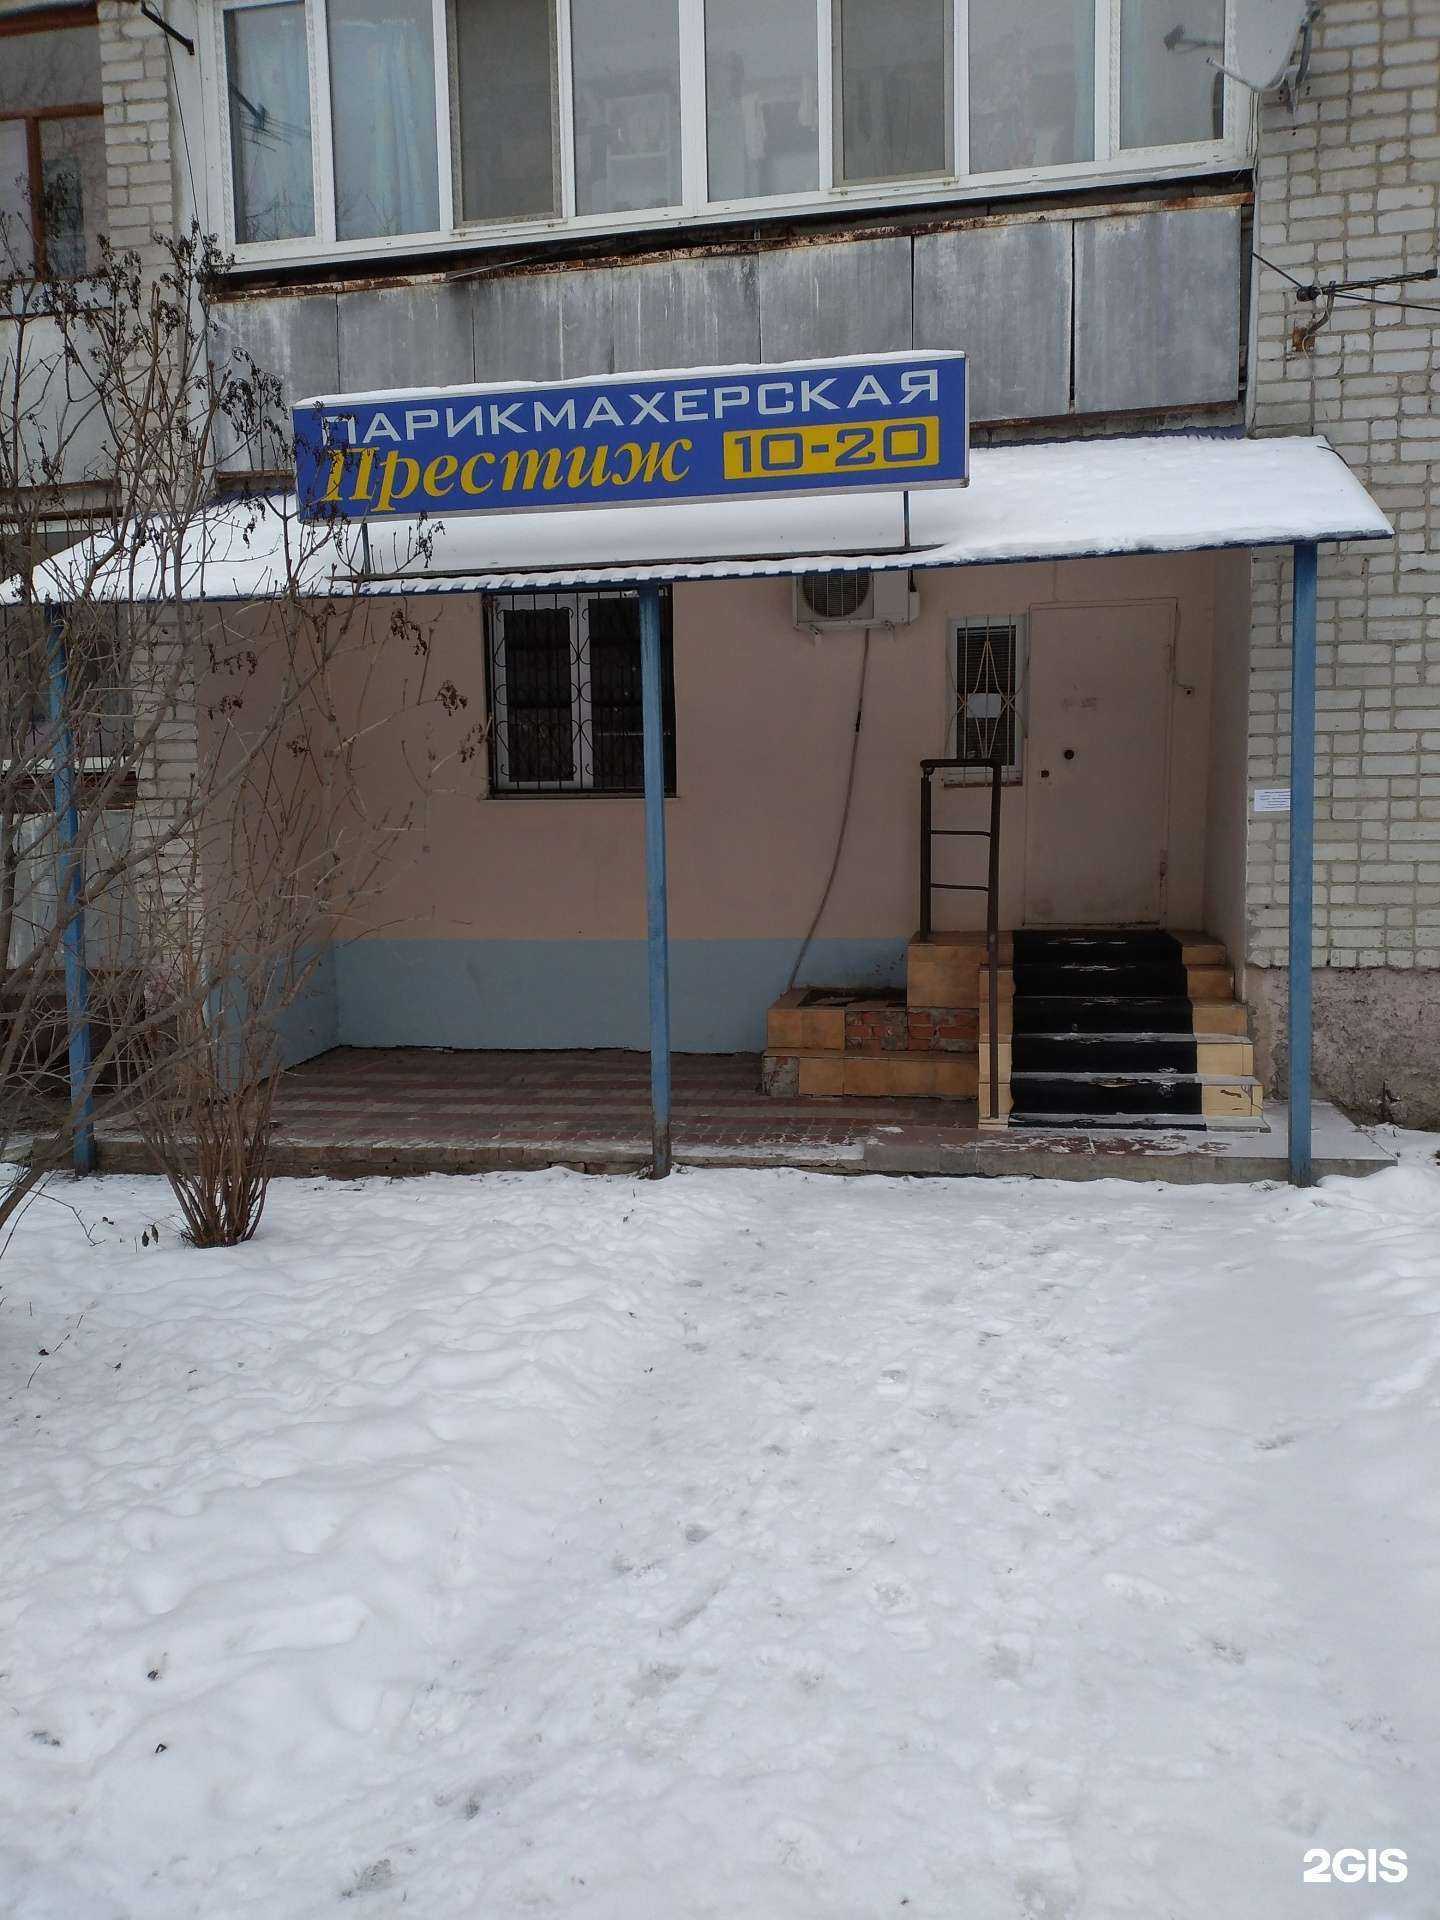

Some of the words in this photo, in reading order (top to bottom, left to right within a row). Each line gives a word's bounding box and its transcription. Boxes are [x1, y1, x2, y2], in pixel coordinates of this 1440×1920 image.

[321, 369, 939, 446] ПАРИКМАХЕРСКАЯ
[320, 438, 692, 512] Престиж
[734, 422, 928, 473] 10-20
